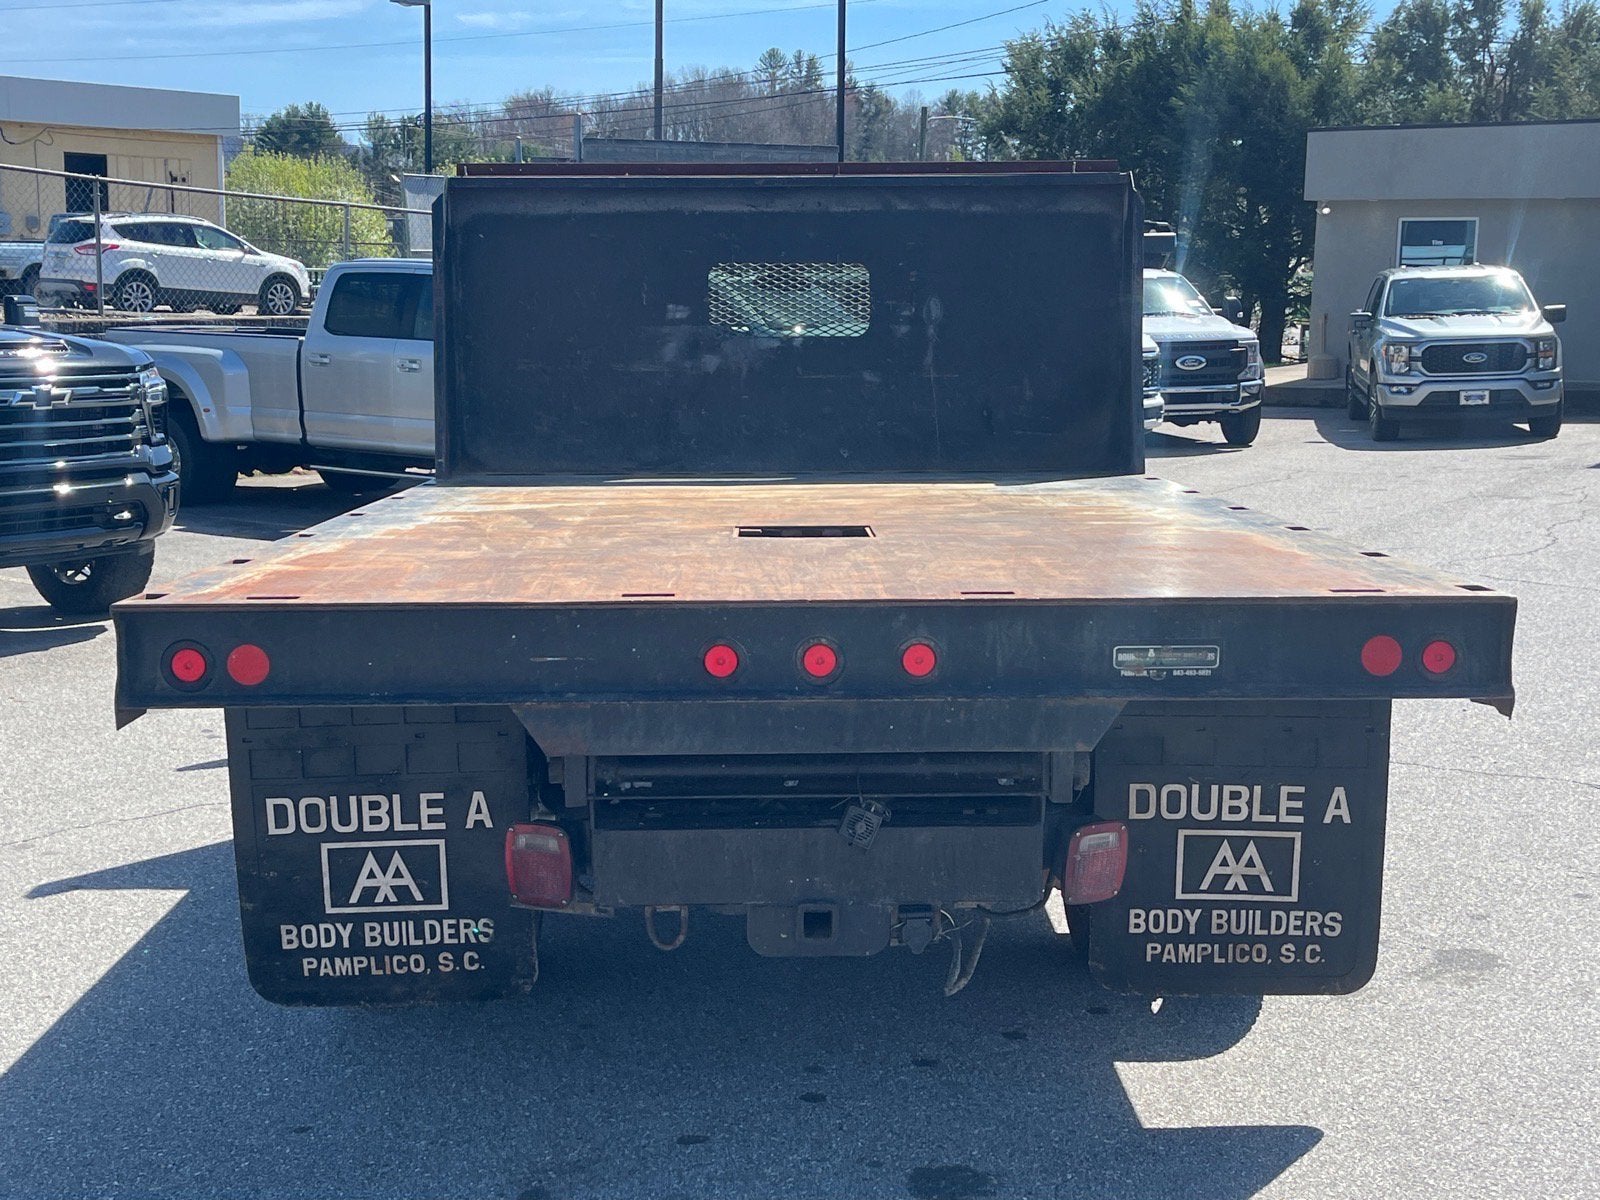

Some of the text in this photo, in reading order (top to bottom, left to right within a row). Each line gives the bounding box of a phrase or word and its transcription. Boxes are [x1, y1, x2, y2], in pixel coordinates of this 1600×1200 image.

[265, 790, 494, 836] DOUBLE A
[1128, 783, 1352, 824] DOUBLE A
[280, 917, 495, 950] BODY BUILDERS
[1128, 908, 1343, 937] BODY BUILDERS
[302, 954, 432, 977] PAMPLICO,
[1146, 943, 1272, 965] PAMPLICO,
